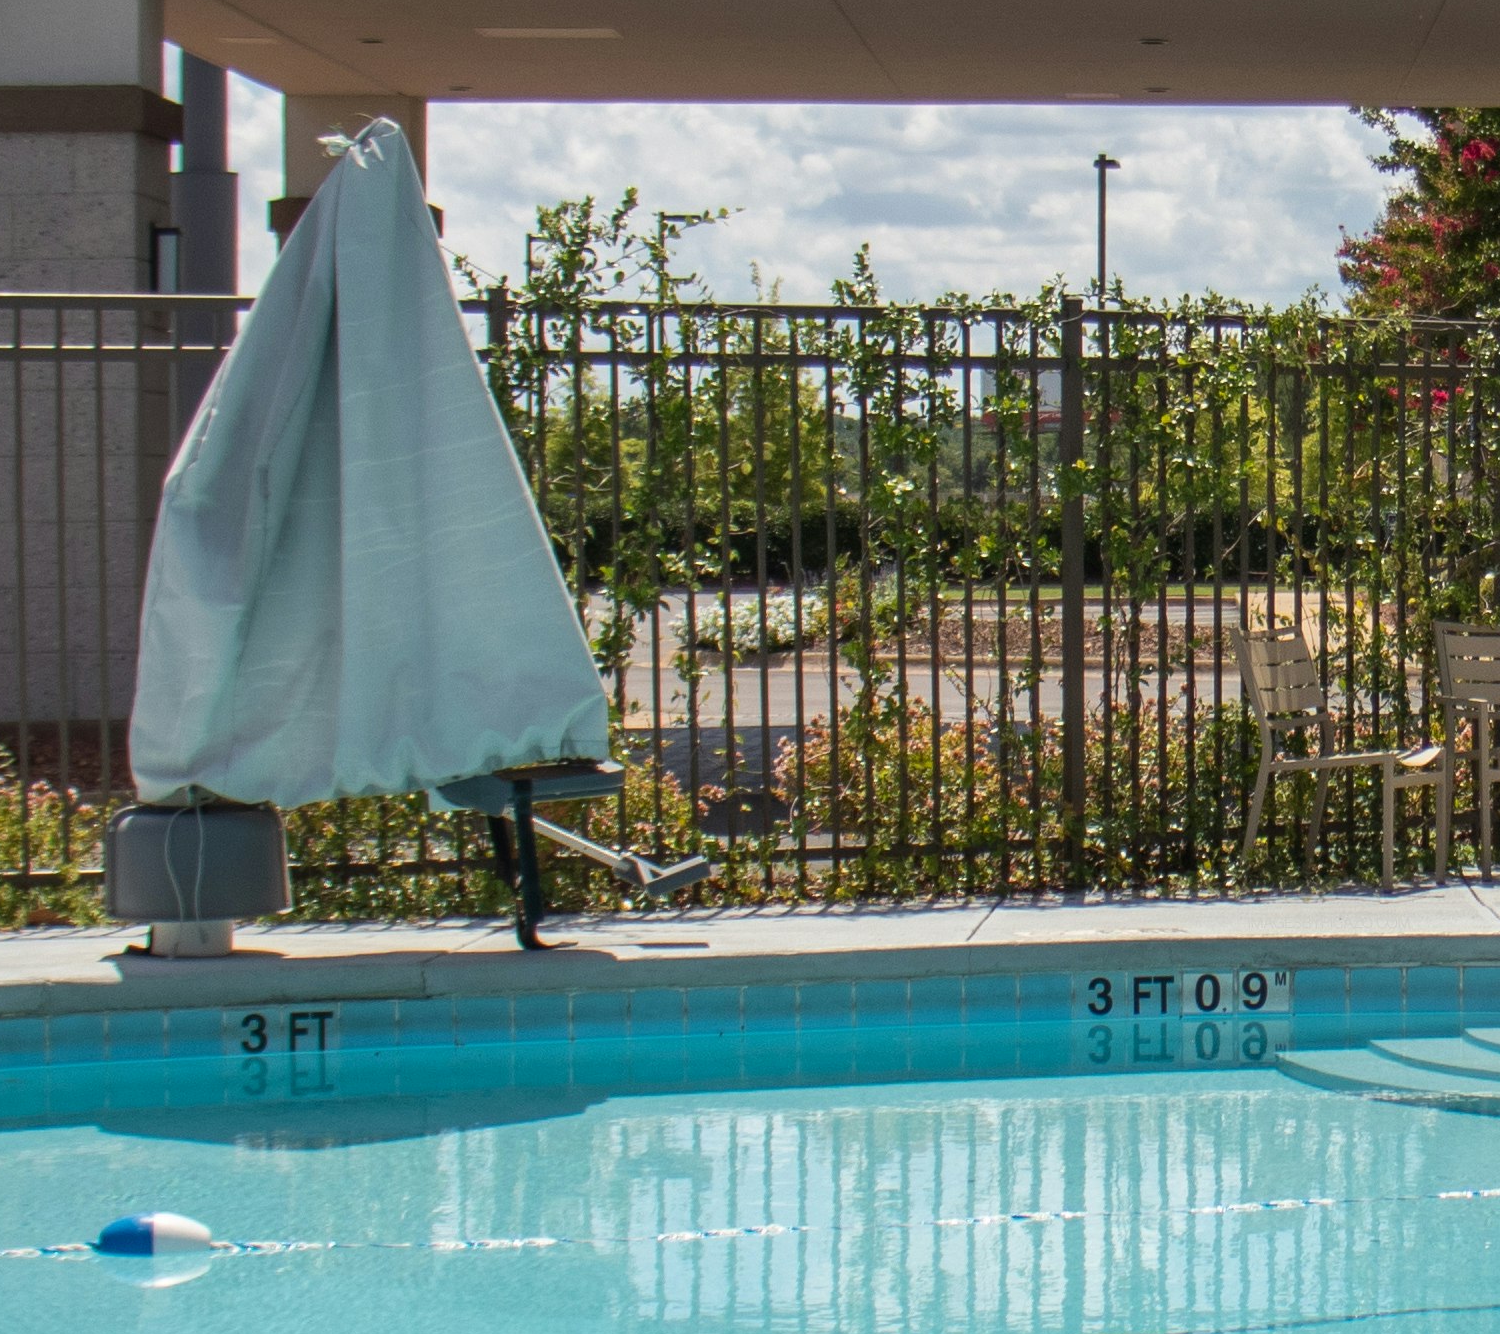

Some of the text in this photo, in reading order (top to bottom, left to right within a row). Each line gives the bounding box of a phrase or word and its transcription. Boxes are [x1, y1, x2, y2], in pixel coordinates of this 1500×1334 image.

[1088, 977, 1113, 1016] 3
[1133, 975, 1175, 1015] FT
[241, 1010, 335, 1054] 3 FT
